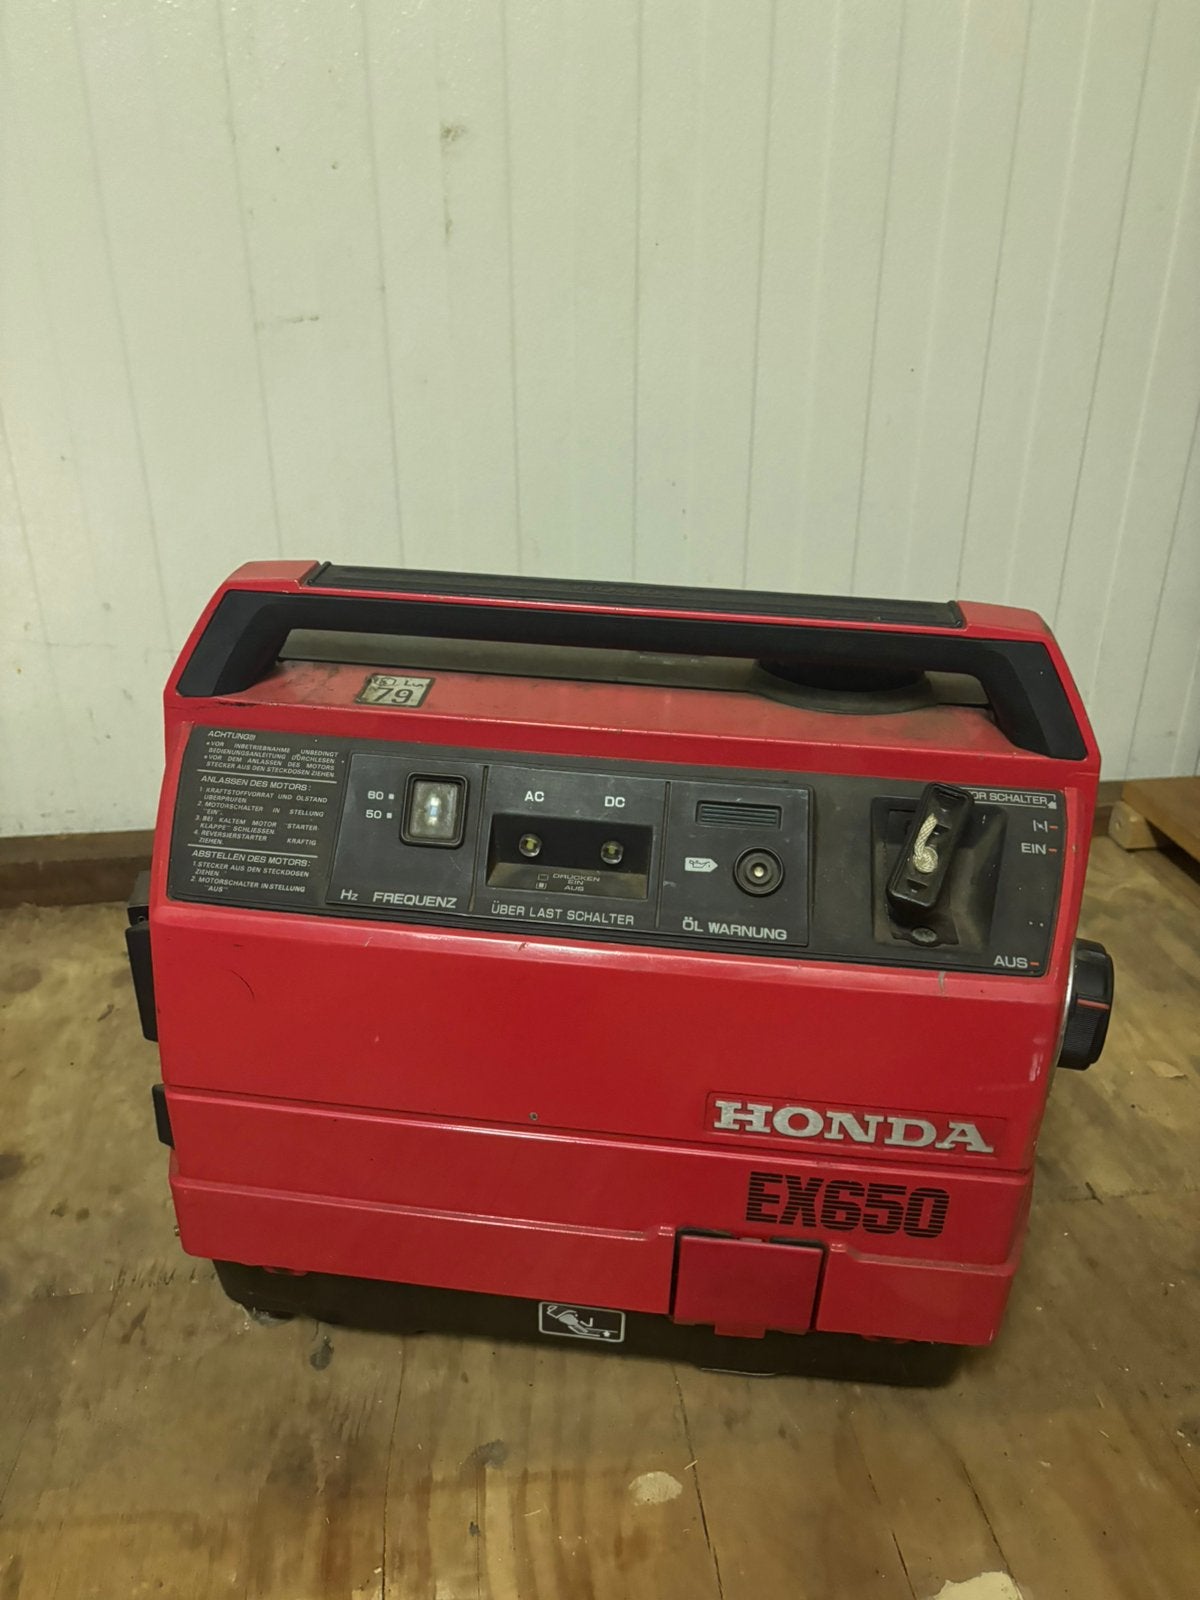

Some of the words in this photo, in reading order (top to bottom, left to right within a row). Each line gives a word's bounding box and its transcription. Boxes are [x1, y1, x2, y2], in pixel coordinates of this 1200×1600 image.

[374, 687, 414, 704] 79
[300, 749, 338, 758] UNBEDINGT
[206, 761, 236, 769] STECKER
[266, 768, 310, 776] STECKDOSEN
[247, 758, 282, 767] ANLASSEN
[306, 763, 335, 771] MOTORS
[200, 775, 248, 786] ANLASSEN
[249, 779, 269, 788] DES
[367, 790, 384, 800] 60
[524, 790, 545, 802] AC
[989, 792, 1048, 805] SCHALTER
[604, 796, 626, 808] DC
[204, 801, 264, 812] MOTORSCHALTER
[289, 809, 324, 818] STELLUNG
[365, 809, 382, 819] 50
[218, 817, 246, 825] KALTEM
[251, 820, 278, 828] MOTOR
[200, 830, 268, 842] REVERSIERSTARTER
[1021, 842, 1047, 855] EIN
[191, 849, 246, 862] ABSTELLEN
[247, 854, 267, 863] DES
[197, 861, 229, 870] STECKER
[262, 867, 310, 878] STECKDOSEN
[198, 876, 260, 888] MOTORSCHALTER
[340, 888, 359, 901] Hz
[372, 891, 458, 909] FREQUENZ
[491, 900, 525, 916] ÜBER
[529, 907, 563, 919] LAST
[566, 910, 635, 925] SCHALTER
[682, 916, 704, 932] ÖL
[708, 922, 788, 941] WARNUNG
[993, 955, 1029, 969] AUS
[713, 1099, 996, 1154] HONDA
[744, 1170, 951, 1240] EX650
